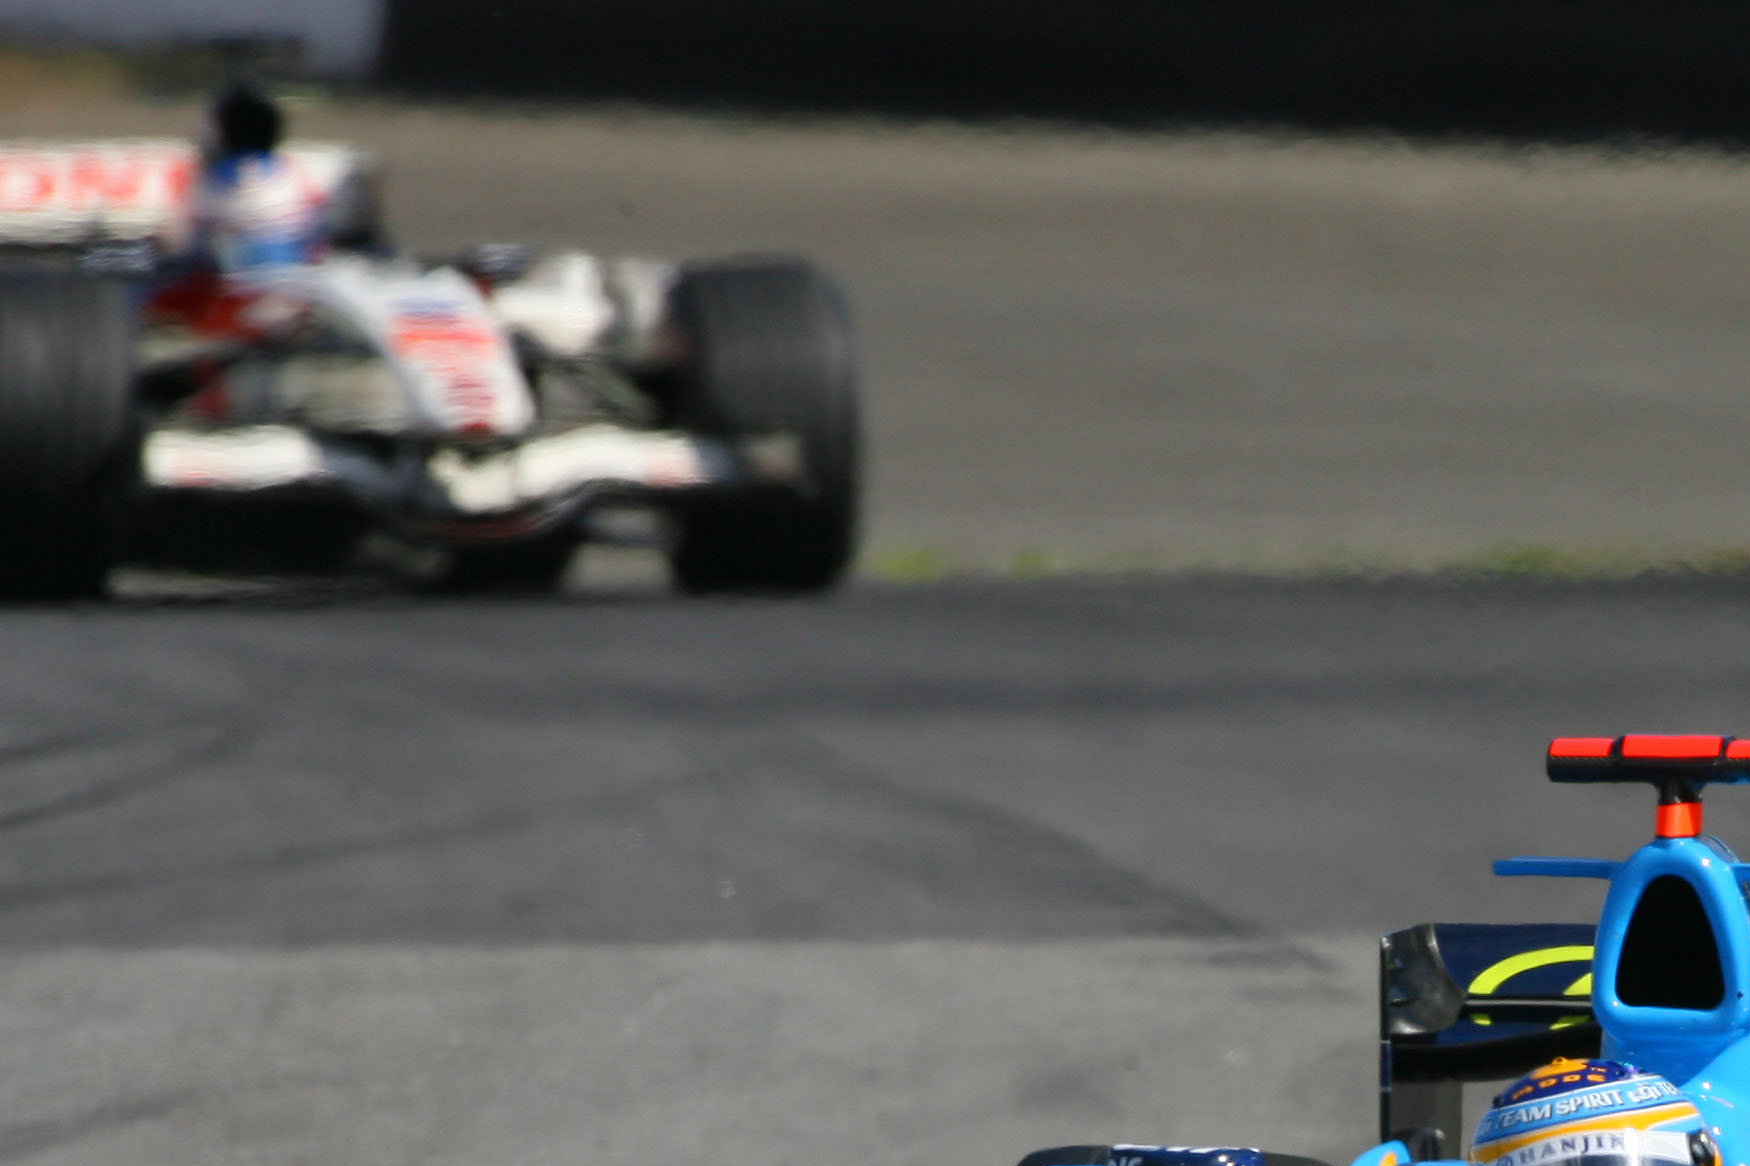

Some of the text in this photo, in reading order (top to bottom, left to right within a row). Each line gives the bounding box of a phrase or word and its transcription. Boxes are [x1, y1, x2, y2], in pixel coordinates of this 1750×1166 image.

[1498, 1101, 1552, 1128] TEAM
[1555, 1088, 1627, 1116] SPIRIT
[1519, 1131, 1624, 1166] HANJIN
